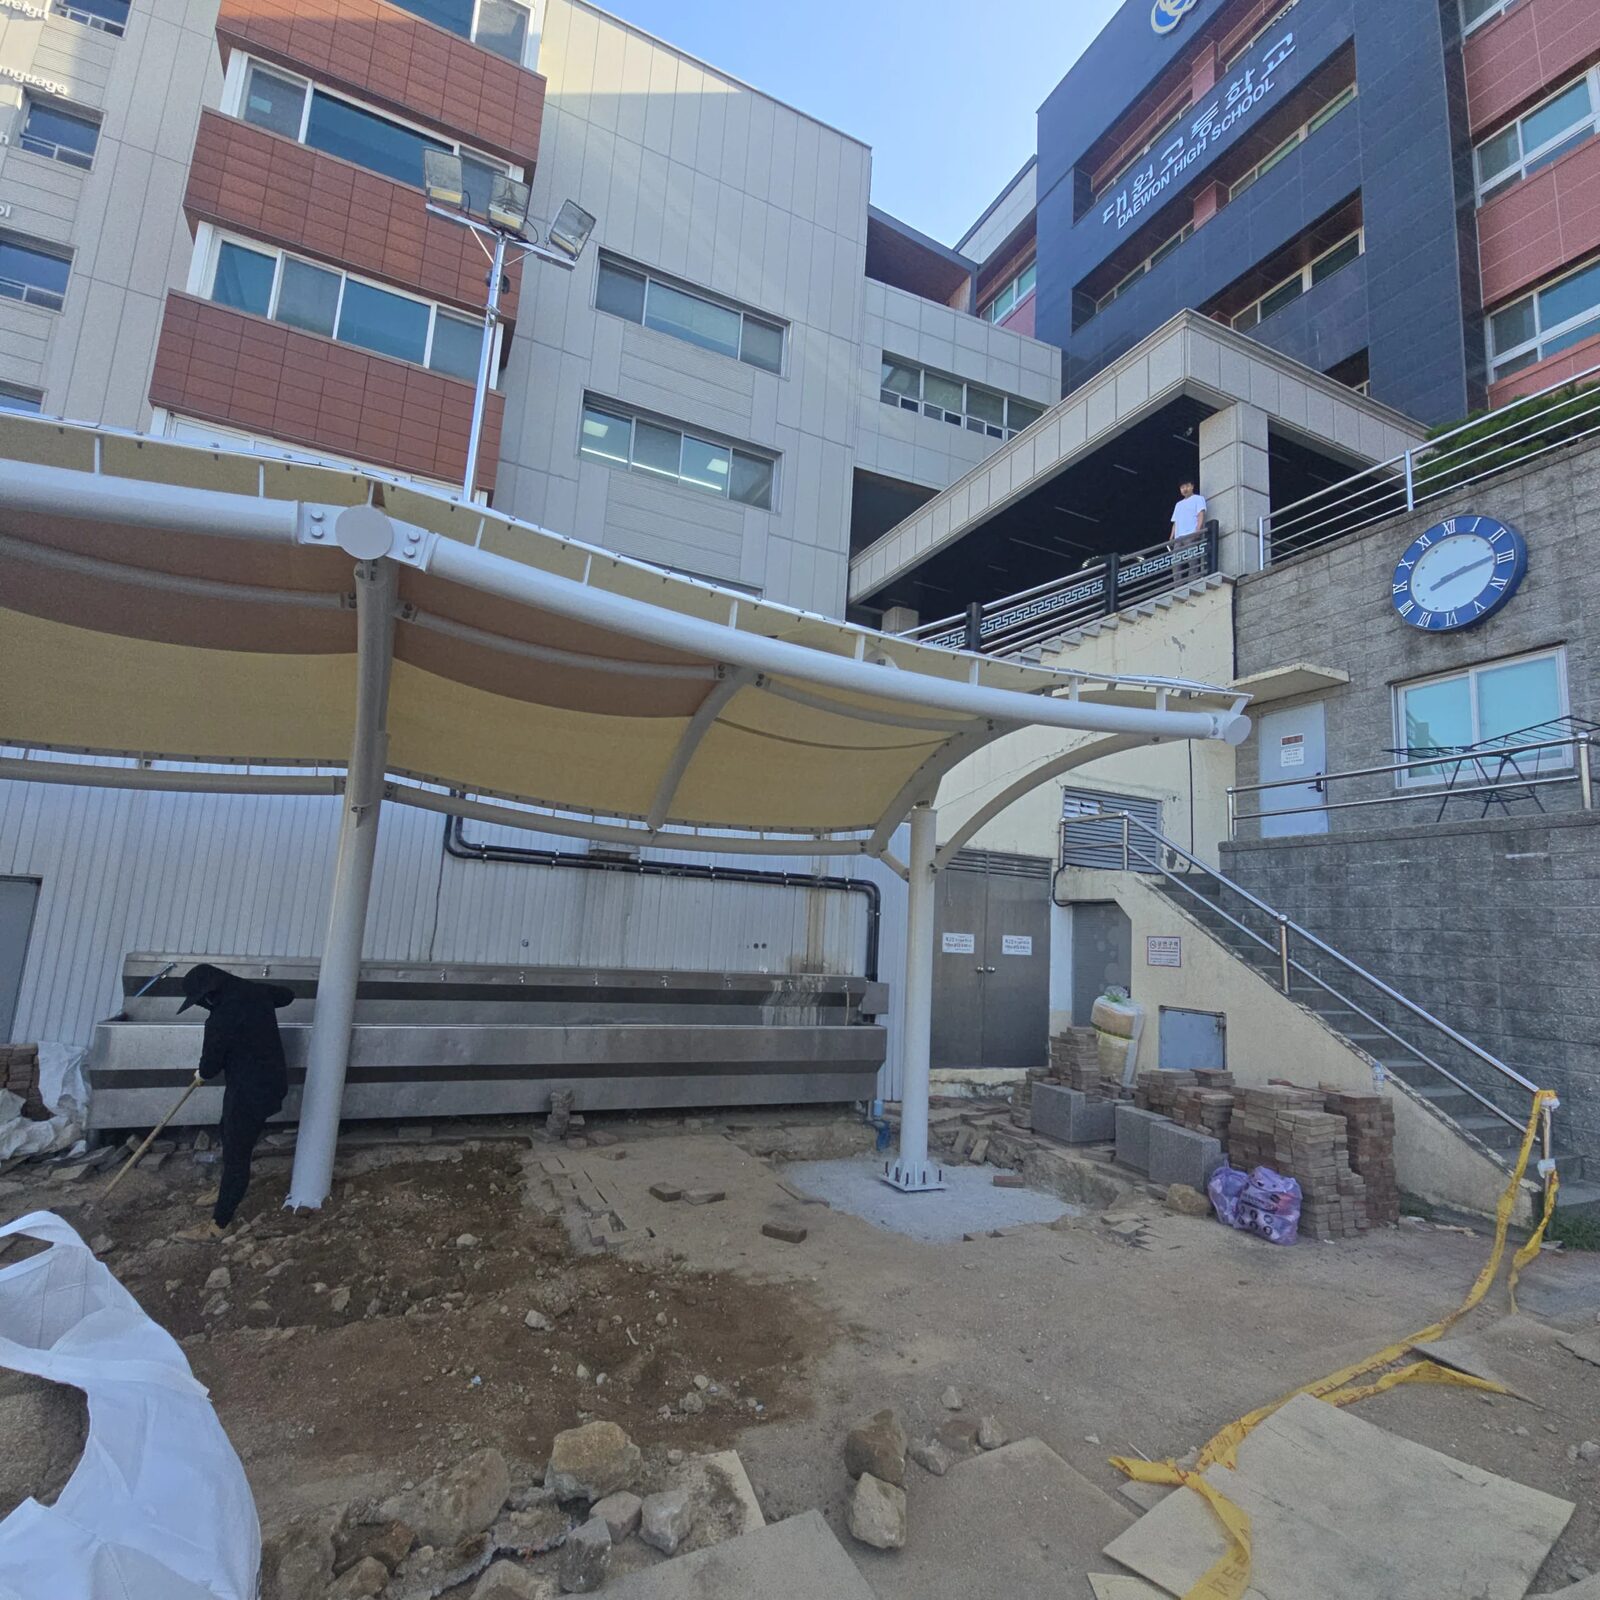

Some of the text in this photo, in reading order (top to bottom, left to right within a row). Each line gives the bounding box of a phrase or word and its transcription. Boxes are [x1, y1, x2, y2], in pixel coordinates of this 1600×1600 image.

[1102, 31, 1297, 225] 대원고등학교
[1117, 77, 1276, 230] DAEWON HIGH SCHOOL
[1442, 519, 1456, 536] XII
[1415, 534, 1432, 551] XI
[1488, 527, 1507, 544] II
[1398, 558, 1415, 570] X
[1497, 549, 1514, 564] III
[1392, 580, 1408, 594] IX
[1490, 576, 1508, 591] IV
[1474, 600, 1486, 615] V
[1446, 611, 1458, 626] VI
